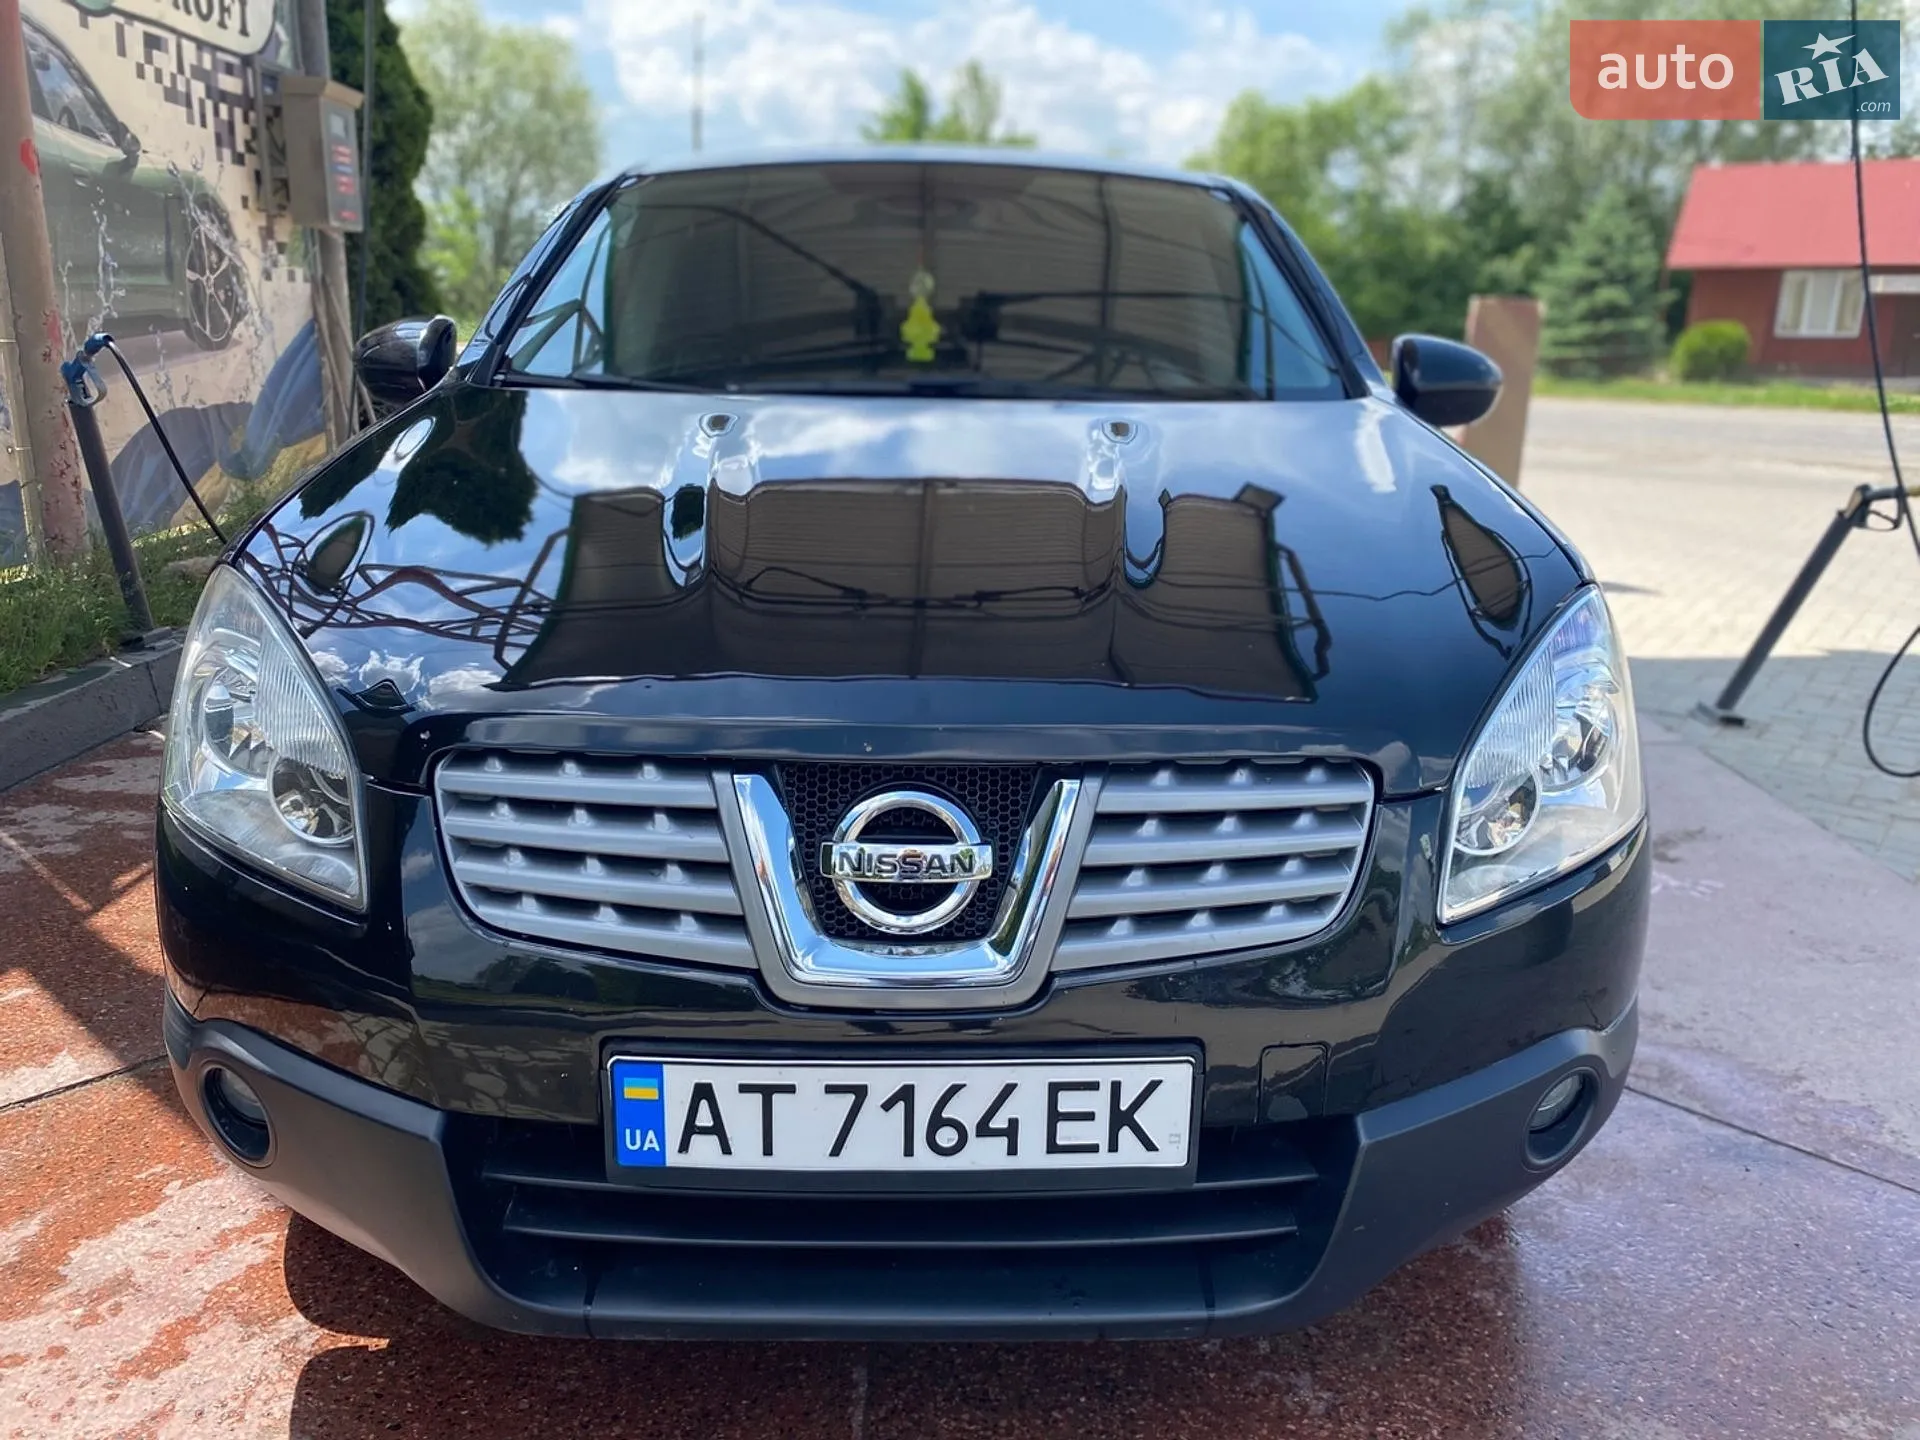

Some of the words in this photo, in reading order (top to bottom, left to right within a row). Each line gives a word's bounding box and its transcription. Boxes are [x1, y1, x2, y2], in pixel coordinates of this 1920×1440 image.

[838, 852, 974, 874] NISSAN
[677, 1081, 796, 1156] AT
[823, 1082, 1018, 1157] 7164
[1046, 1079, 1163, 1154] EK
[625, 1129, 660, 1152] UA
